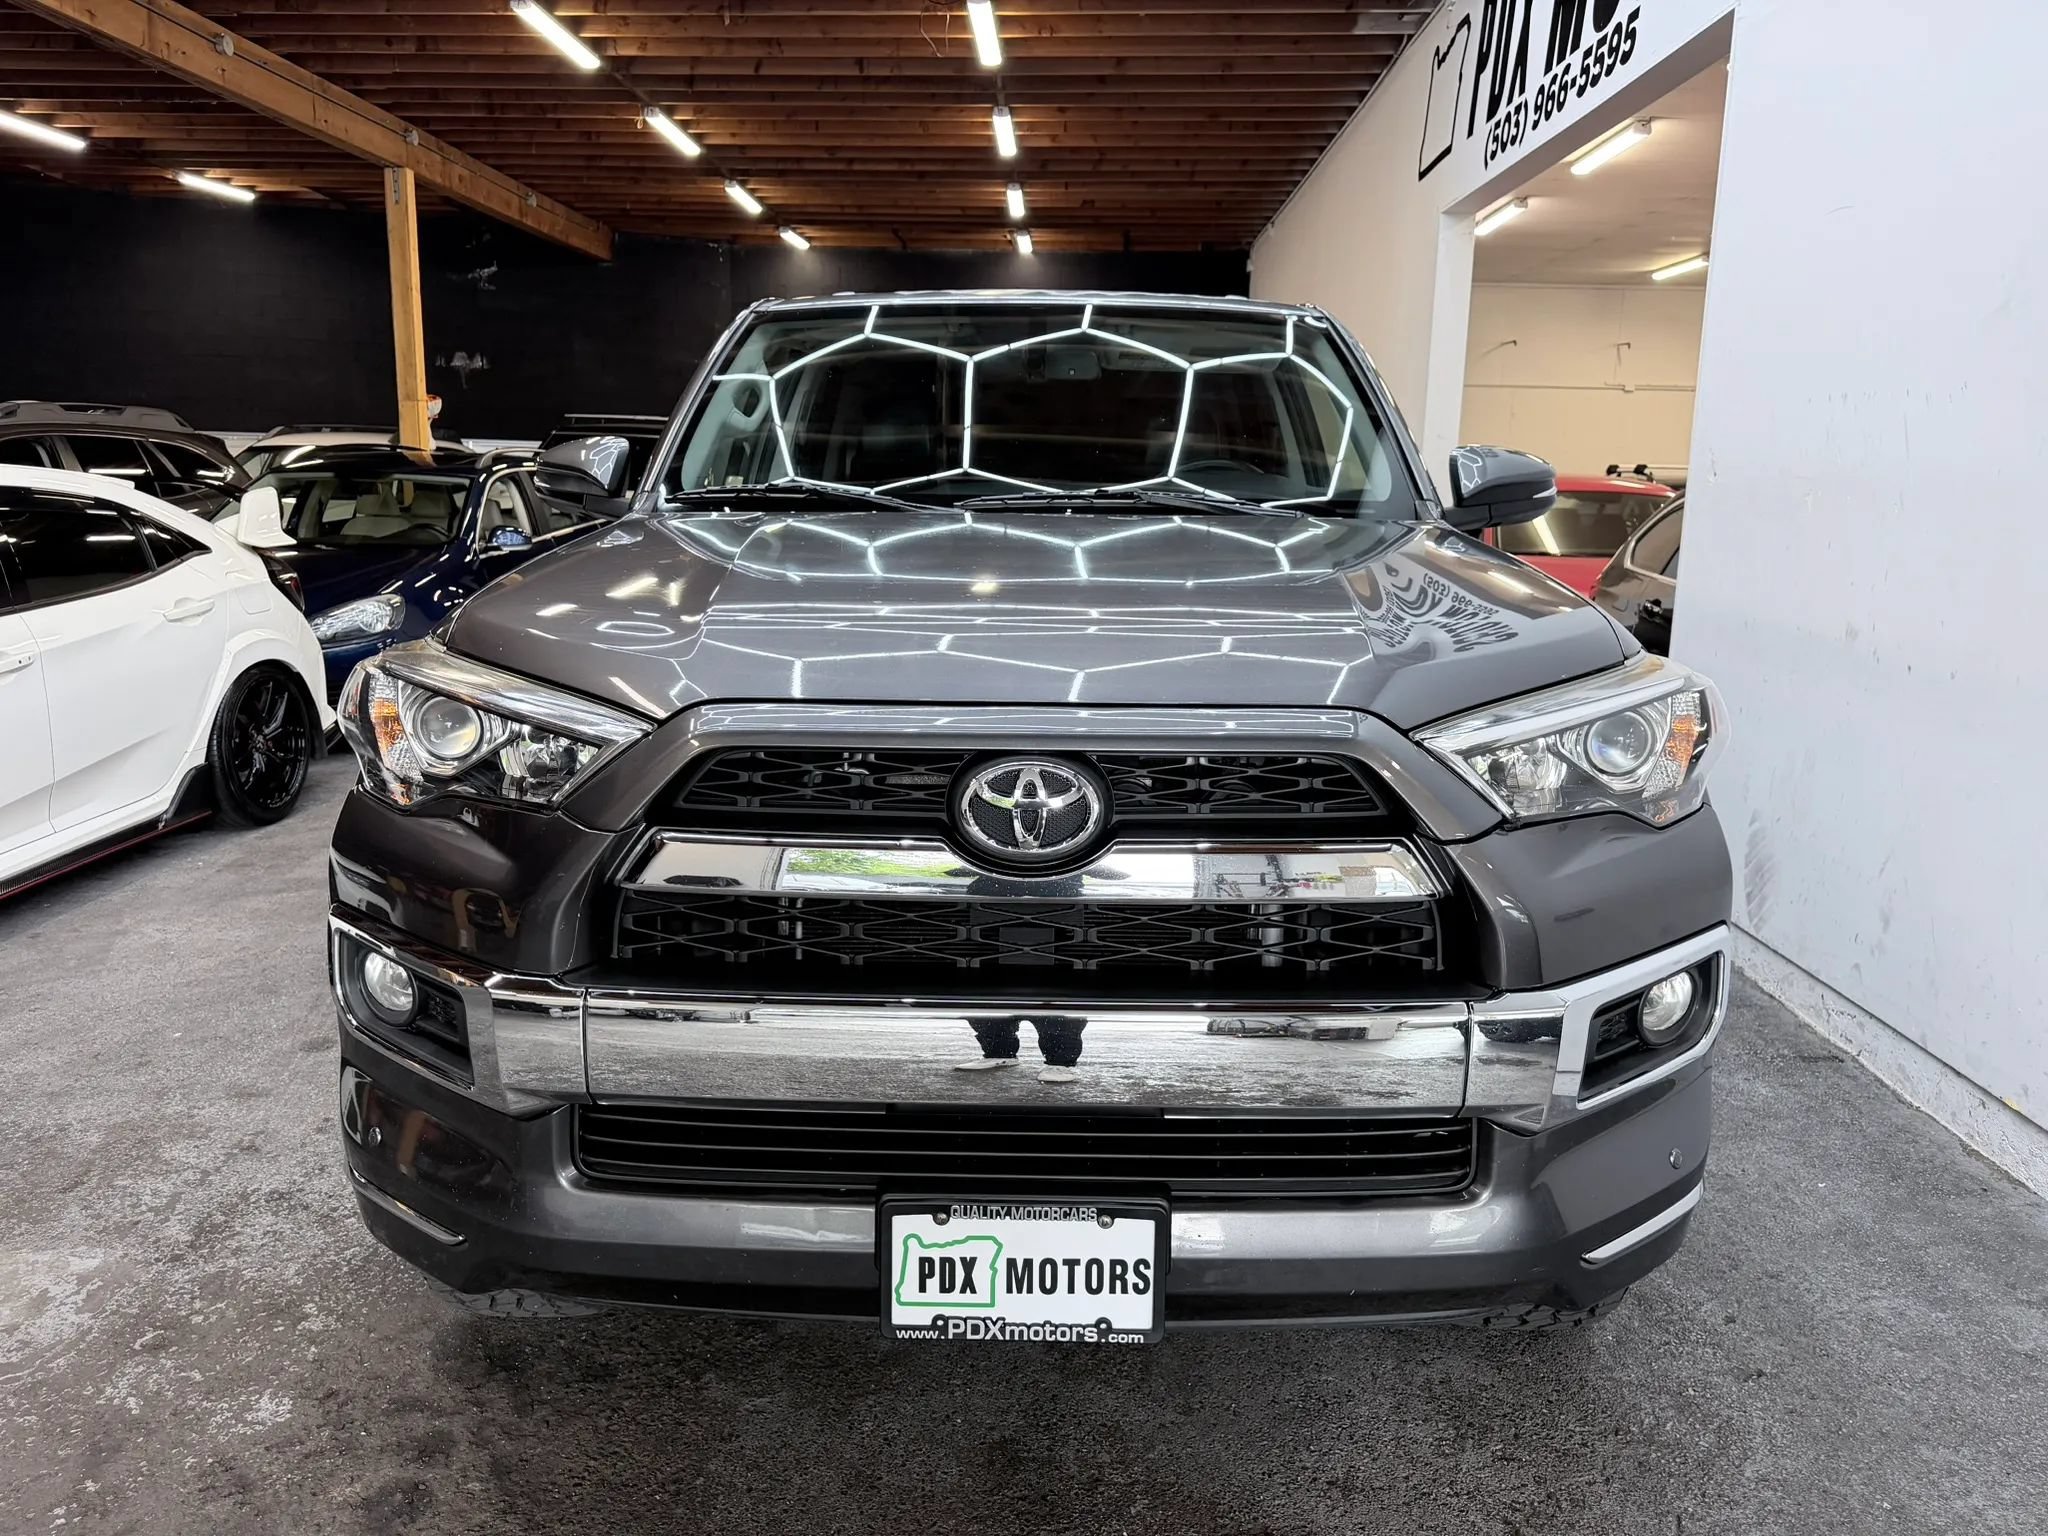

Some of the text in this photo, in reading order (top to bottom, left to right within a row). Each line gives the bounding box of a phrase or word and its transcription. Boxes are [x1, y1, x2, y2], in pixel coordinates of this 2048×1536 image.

[1467, 0, 1533, 139] PDX
[1484, 5, 1641, 171] (503) 966-5595
[950, 1205, 1098, 1222] QUALITY MOTORCARS
[918, 1256, 1151, 1295] PDX MOTORS
[896, 1319, 1144, 1344] www.PDXmotors.com
